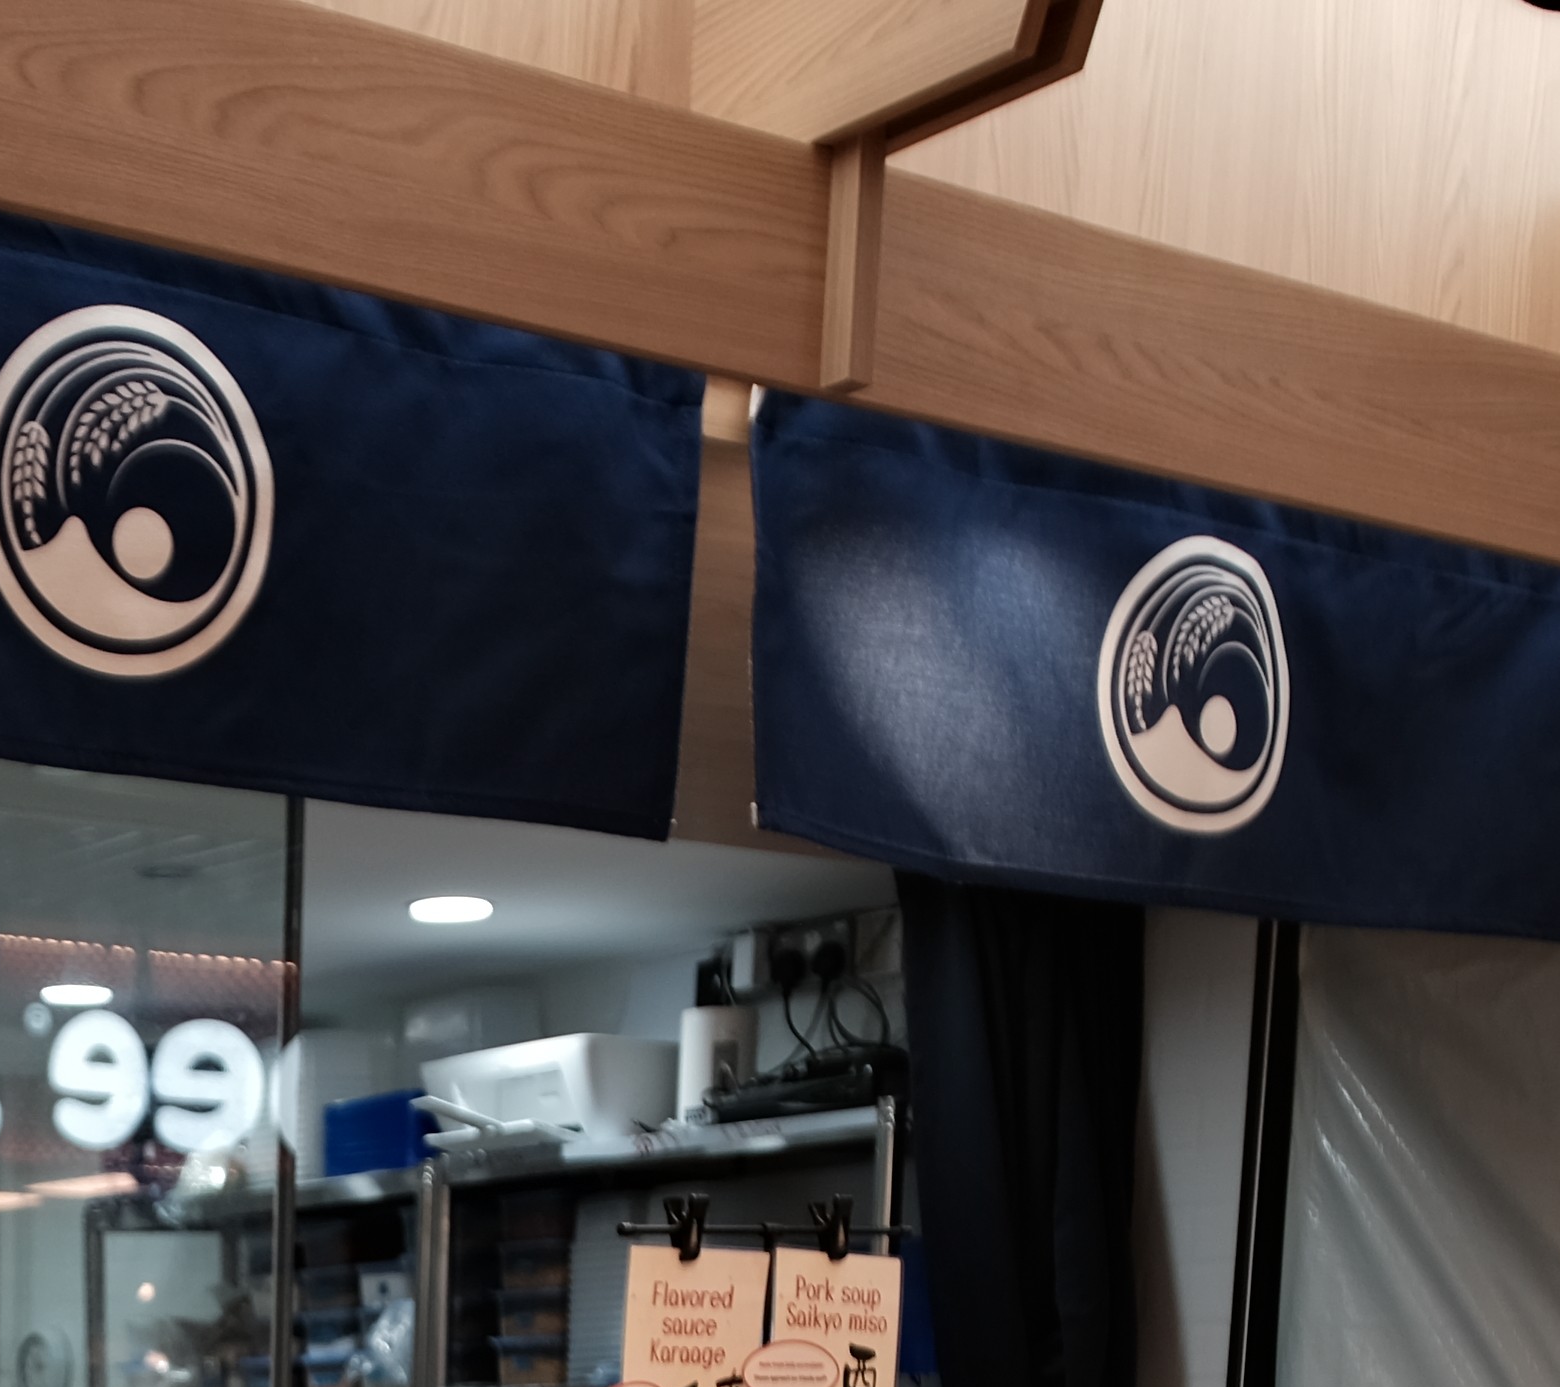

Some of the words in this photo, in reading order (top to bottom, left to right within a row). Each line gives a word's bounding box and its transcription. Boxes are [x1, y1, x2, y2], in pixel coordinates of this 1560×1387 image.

[652, 1280, 734, 1311] Flavored
[795, 1275, 836, 1302] Pork
[841, 1279, 881, 1308] soup
[662, 1313, 718, 1336] sauce
[785, 1303, 844, 1335] Saikyo
[848, 1308, 888, 1333] miso
[650, 1342, 726, 1366] Karaage
